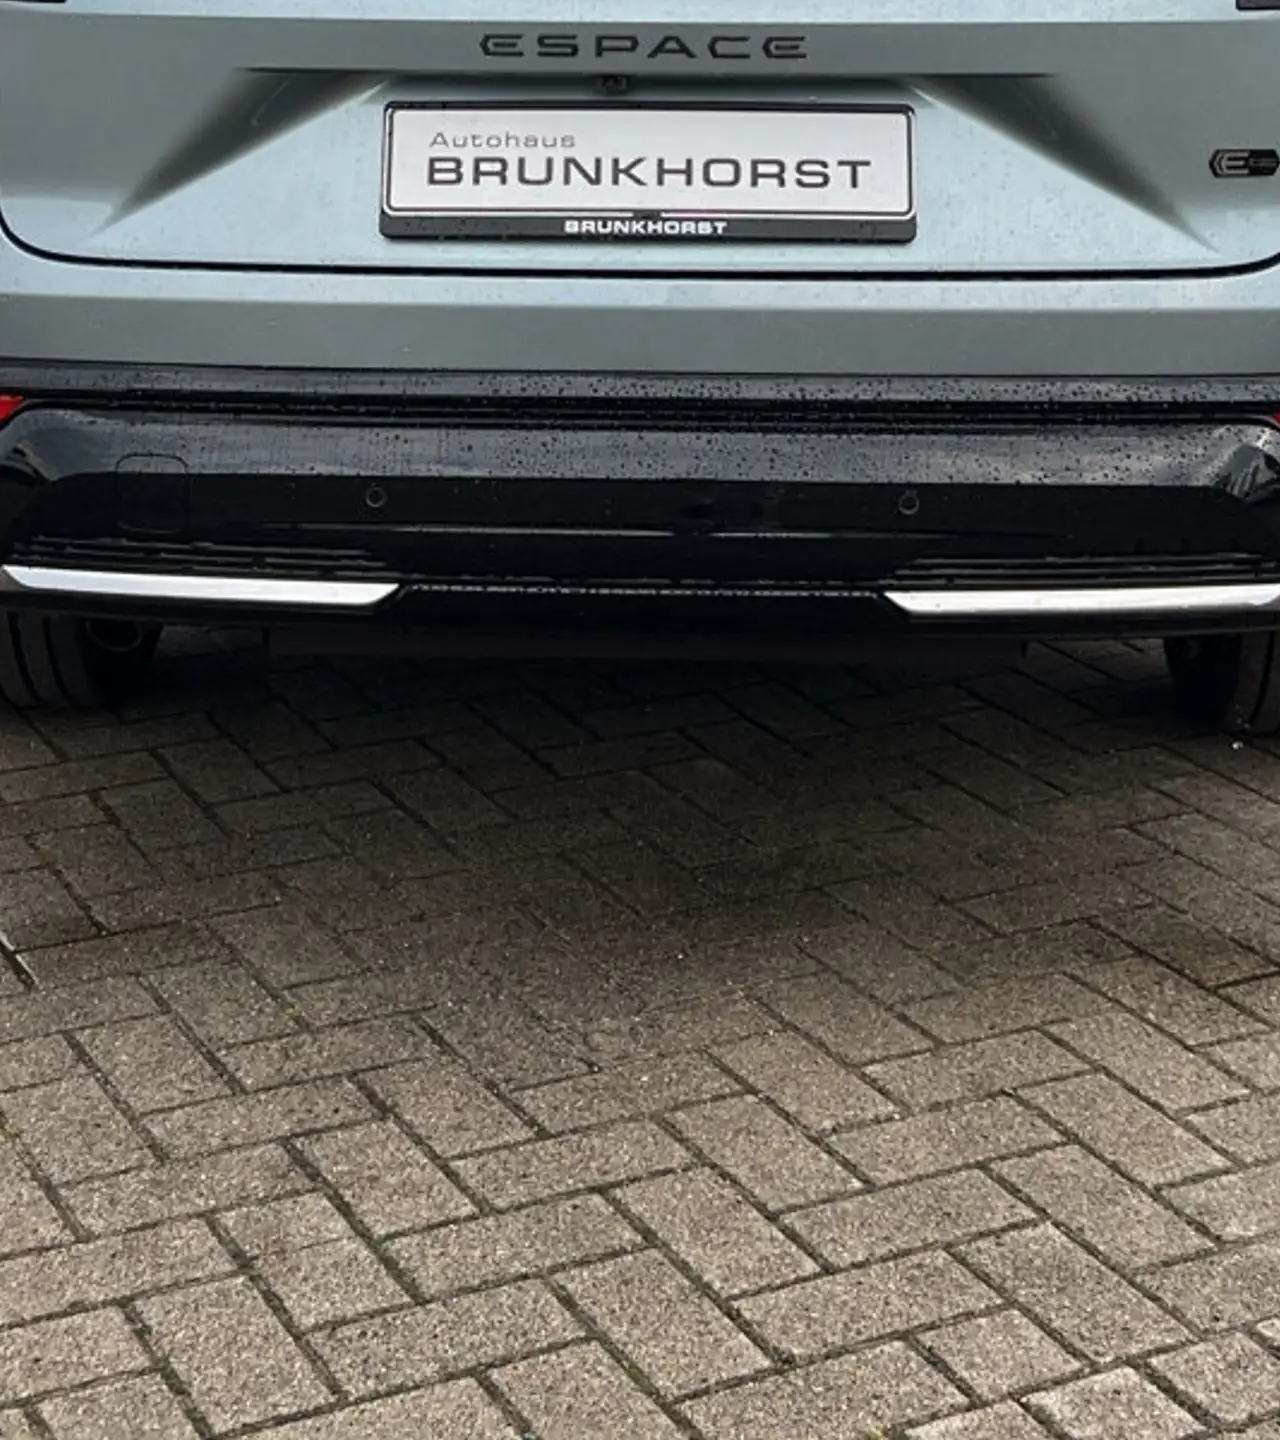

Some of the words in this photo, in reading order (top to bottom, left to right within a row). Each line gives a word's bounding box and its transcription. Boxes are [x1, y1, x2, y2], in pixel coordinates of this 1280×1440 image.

[479, 34, 808, 60] ESPACE
[428, 129, 577, 150] Autohaus
[426, 155, 872, 190] BRUNKHORST
[563, 219, 729, 237] BRUNKHORST
